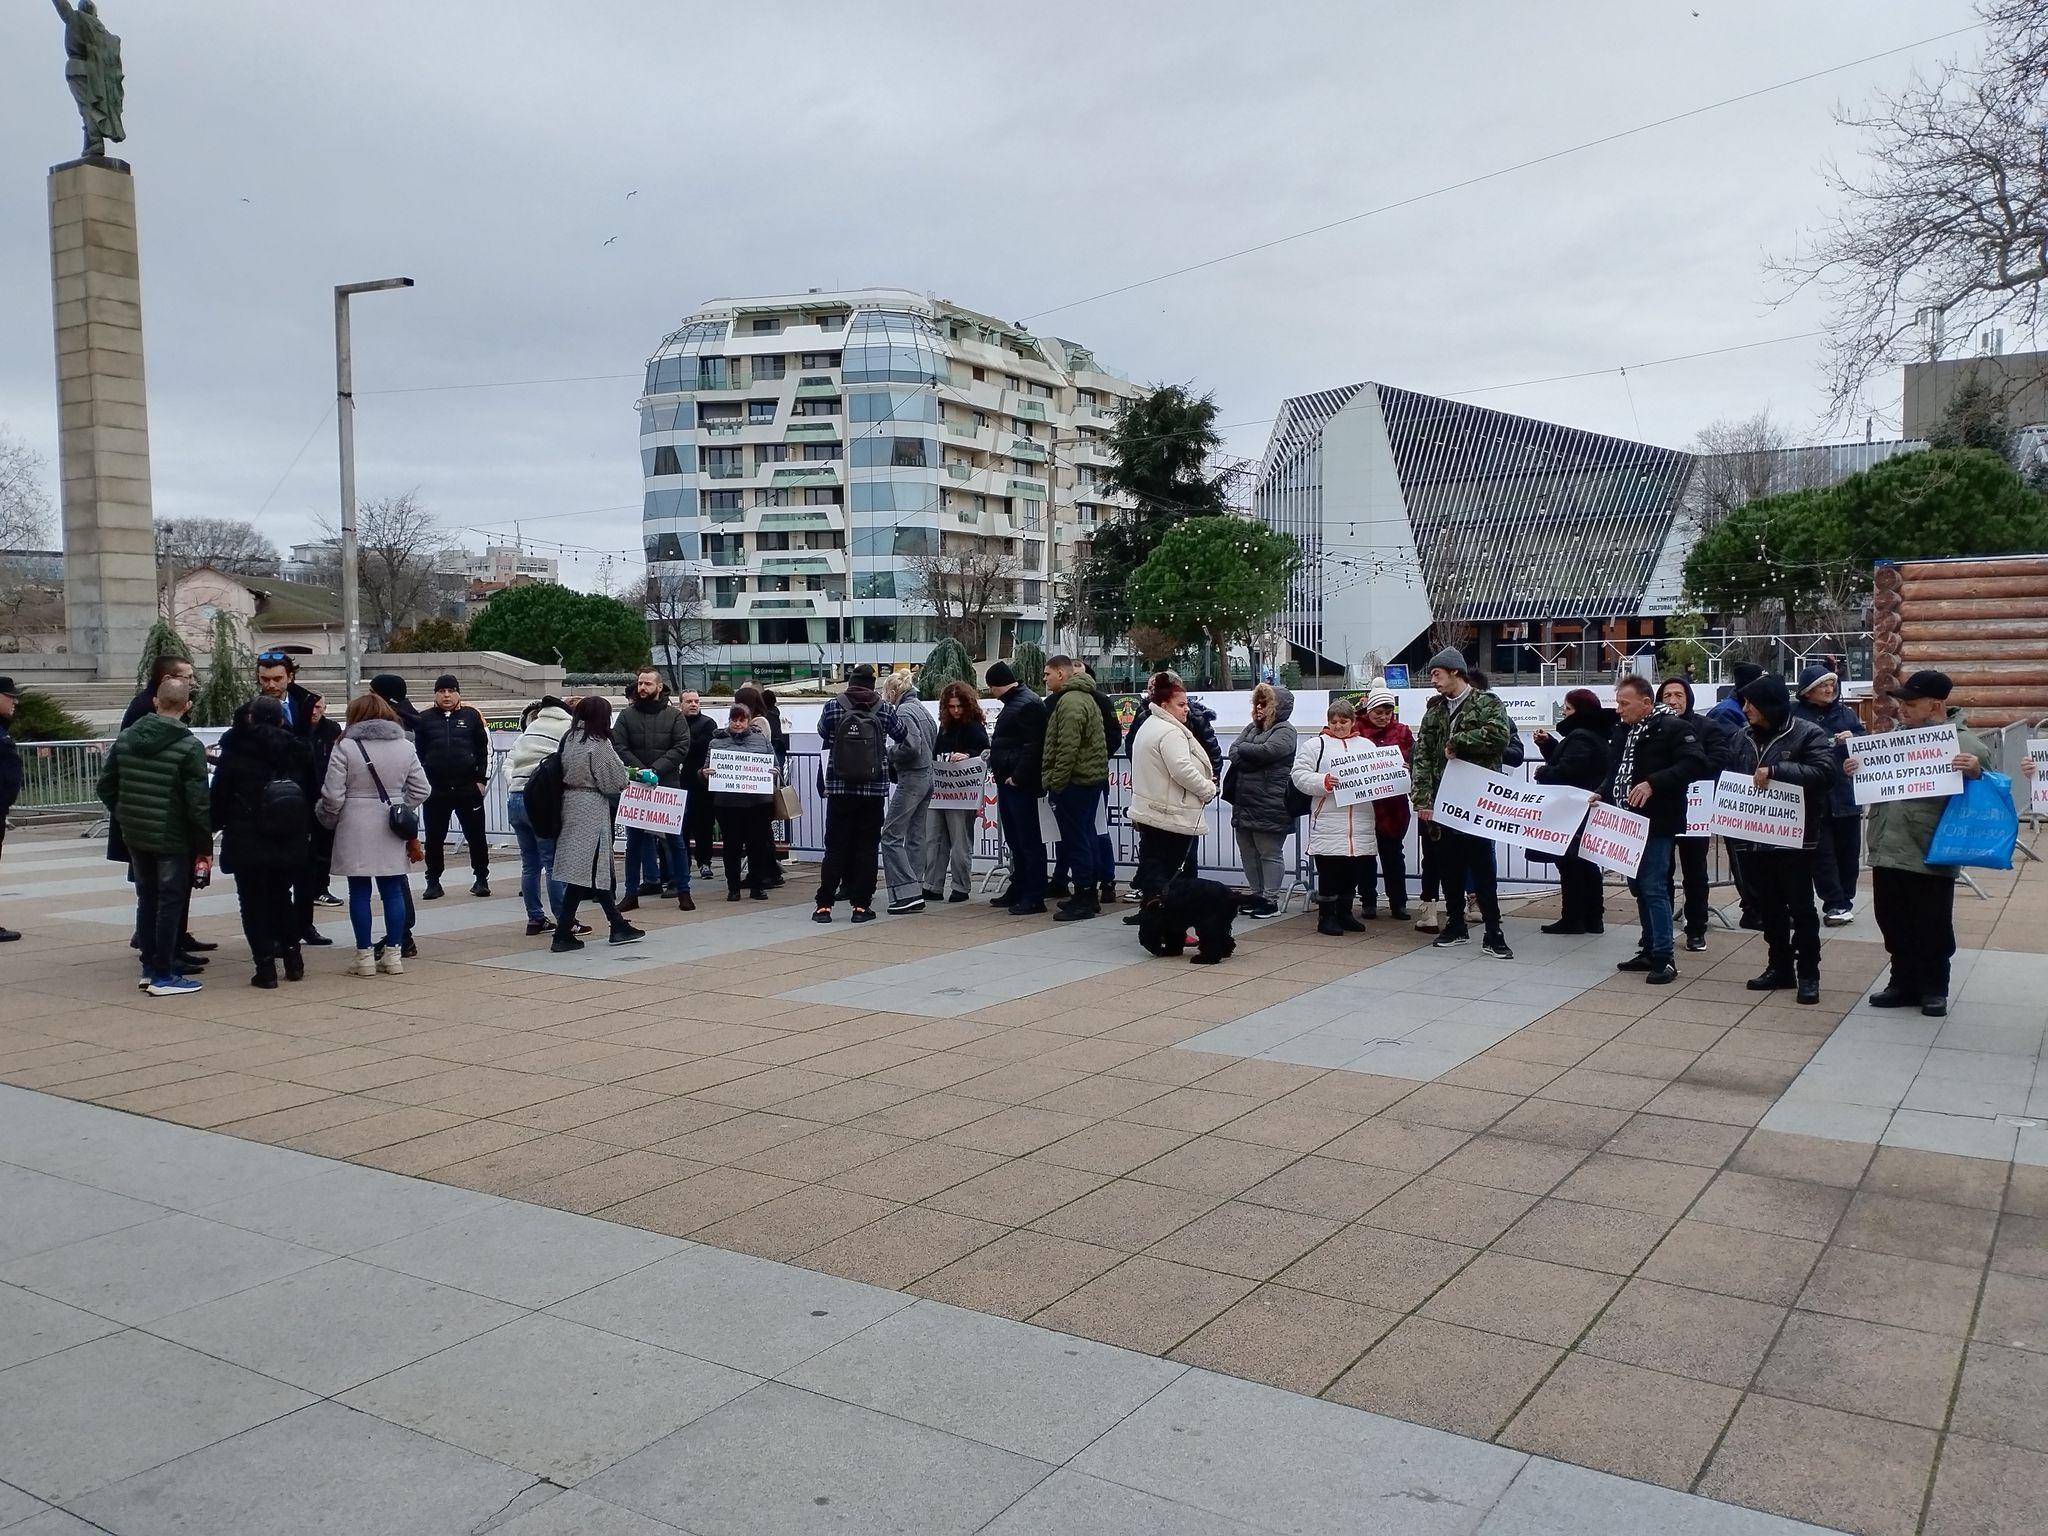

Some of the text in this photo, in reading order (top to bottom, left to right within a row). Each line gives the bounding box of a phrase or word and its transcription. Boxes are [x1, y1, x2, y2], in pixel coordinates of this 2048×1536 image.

[1852, 730, 1955, 754] ДЕЦАТА ИМАТ НУЖДА
[712, 753, 734, 761] ДЕЦАТА
[735, 754, 751, 762] ИМАТ
[1330, 749, 1400, 768] ДЕЦАТА ИМАТ НУЖДА
[1863, 755, 1891, 767] САМО
[1893, 753, 1905, 763] ОТ
[1907, 746, 1943, 761] МАЙКА
[717, 763, 734, 771] САМО
[743, 764, 763, 773] МАЙКА
[735, 774, 771, 782] БУРГАЗЛИЕВ
[1339, 767, 1360, 778] САМО
[1360, 765, 1369, 773] ОТ
[1370, 760, 1394, 771] МАЙКА
[1855, 763, 1958, 784] НИКОЛА БУРГАЗЛИЕВ
[1334, 770, 1407, 791] НИКОЛА БУРГАЗЛИЕВ
[1880, 781, 1935, 797] ИМ Я ОТНЕ!
[624, 786, 683, 807] ДЕЦАТА ПИТАТ...
[1355, 784, 1395, 799] ИМ Я ОТНЕ!
[1487, 781, 1546, 804] ТОВА НЕ Е
[1687, 798, 1702, 806] НТ!
[1718, 780, 1801, 804] НИКОЛА БУРГАЗЛИЕВ
[618, 804, 638, 821] КЪДЕ
[639, 808, 645, 821] Е
[1476, 797, 1543, 822] ИНЦИДЕНТ!
[1718, 797, 1798, 822] ИСКА ВТОРИ ШАНС,
[1441, 802, 1570, 845] ТОВА Е ОТНЕТ ЖИВОТ!
[1591, 809, 1645, 841] ДЕЦАТА ПИТАТ...
[1686, 823, 1710, 831] ВОТ!
[1710, 813, 1803, 838] А ХРИСИ ИМАЛА ЛИ Е?
[1581, 832, 1603, 854] КЪДЕ
[1601, 839, 1609, 855] Е
